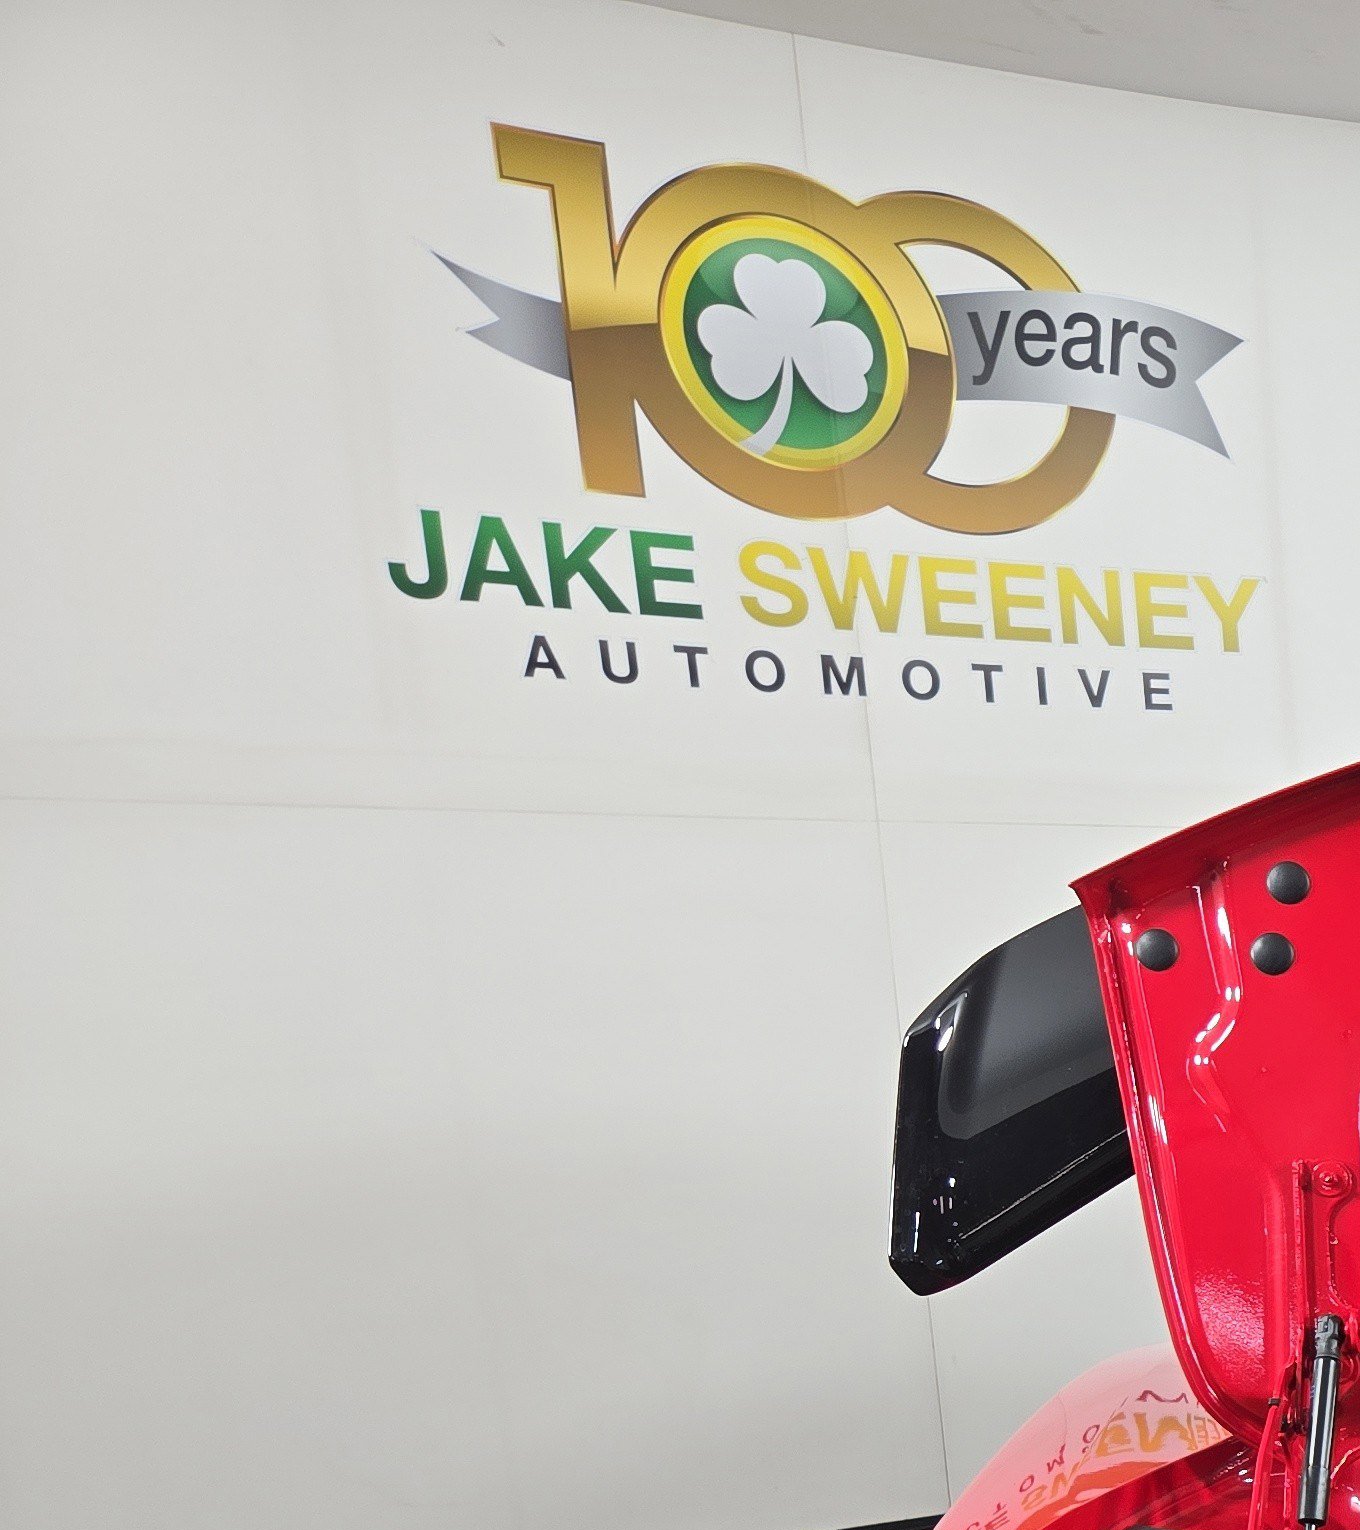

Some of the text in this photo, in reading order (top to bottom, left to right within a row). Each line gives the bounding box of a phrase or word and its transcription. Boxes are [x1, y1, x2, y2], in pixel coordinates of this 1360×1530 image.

[491, 121, 1116, 536] 100
[967, 308, 1178, 388] years
[387, 509, 1261, 654] JAKE SWEENEY
[523, 635, 1174, 712] AUTOMOTIVE
